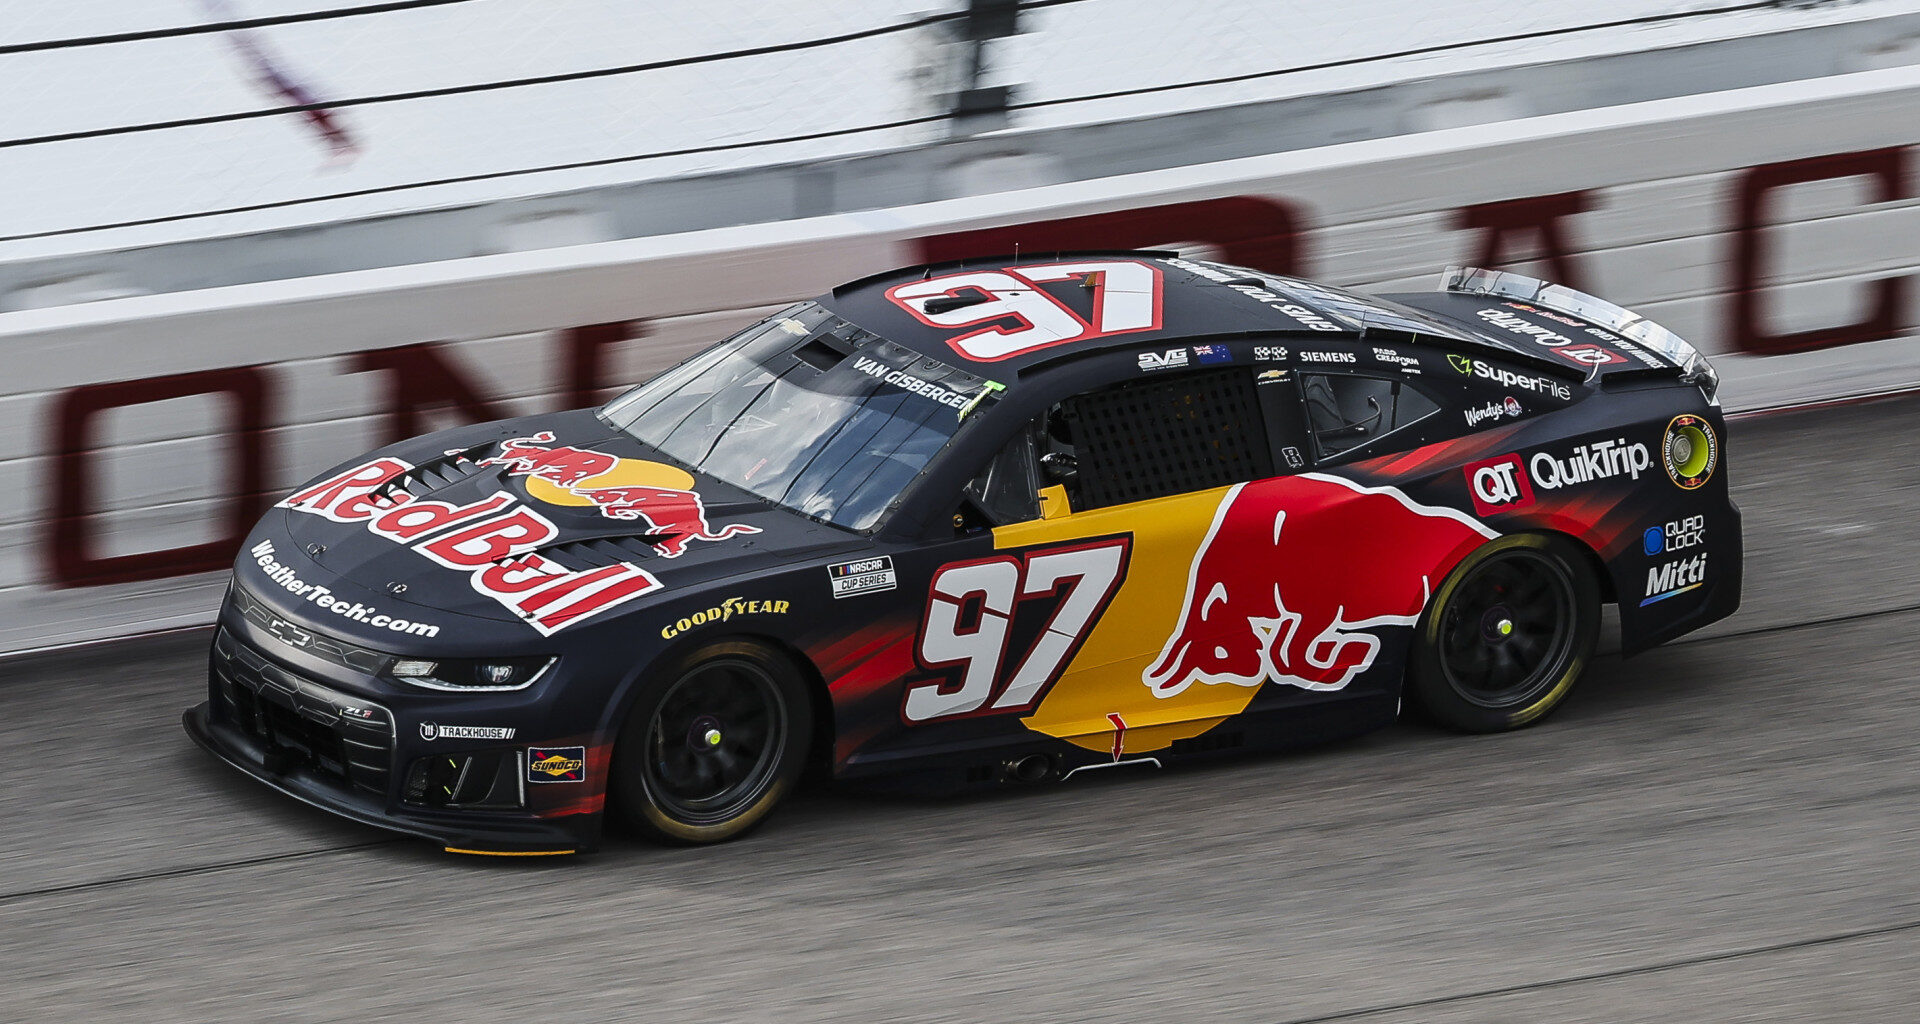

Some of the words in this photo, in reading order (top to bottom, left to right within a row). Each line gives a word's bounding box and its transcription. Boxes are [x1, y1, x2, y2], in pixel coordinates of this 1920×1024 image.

[885, 260, 1165, 362] 97
[1476, 308, 1572, 346] QuikTrip
[852, 356, 890, 378] VAN
[1138, 347, 1189, 367] SVG
[1300, 351, 1357, 363] SIEMENS
[1375, 353, 1420, 367] CREAFORM
[1472, 359, 1571, 400] SuperFile
[1464, 401, 1503, 427] Wendy's
[1665, 430, 1679, 480] TRACKHOUSE
[1702, 424, 1715, 474] TRACKHOUSE
[1530, 437, 1649, 490] QuikTrip
[1473, 461, 1517, 504] QT
[1665, 514, 1704, 537] QUAD
[273, 456, 518, 545] Red
[411, 504, 665, 638] Bull
[1665, 529, 1704, 552] LOCK
[849, 559, 883, 574] NASCAR
[1645, 553, 1707, 596] Mitti
[841, 576, 859, 590] CUP
[858, 573, 887, 587] SERIES
[901, 534, 1131, 726] 97
[442, 725, 504, 739] TRACKHOUSE
[532, 759, 581, 771] SUNOCO
